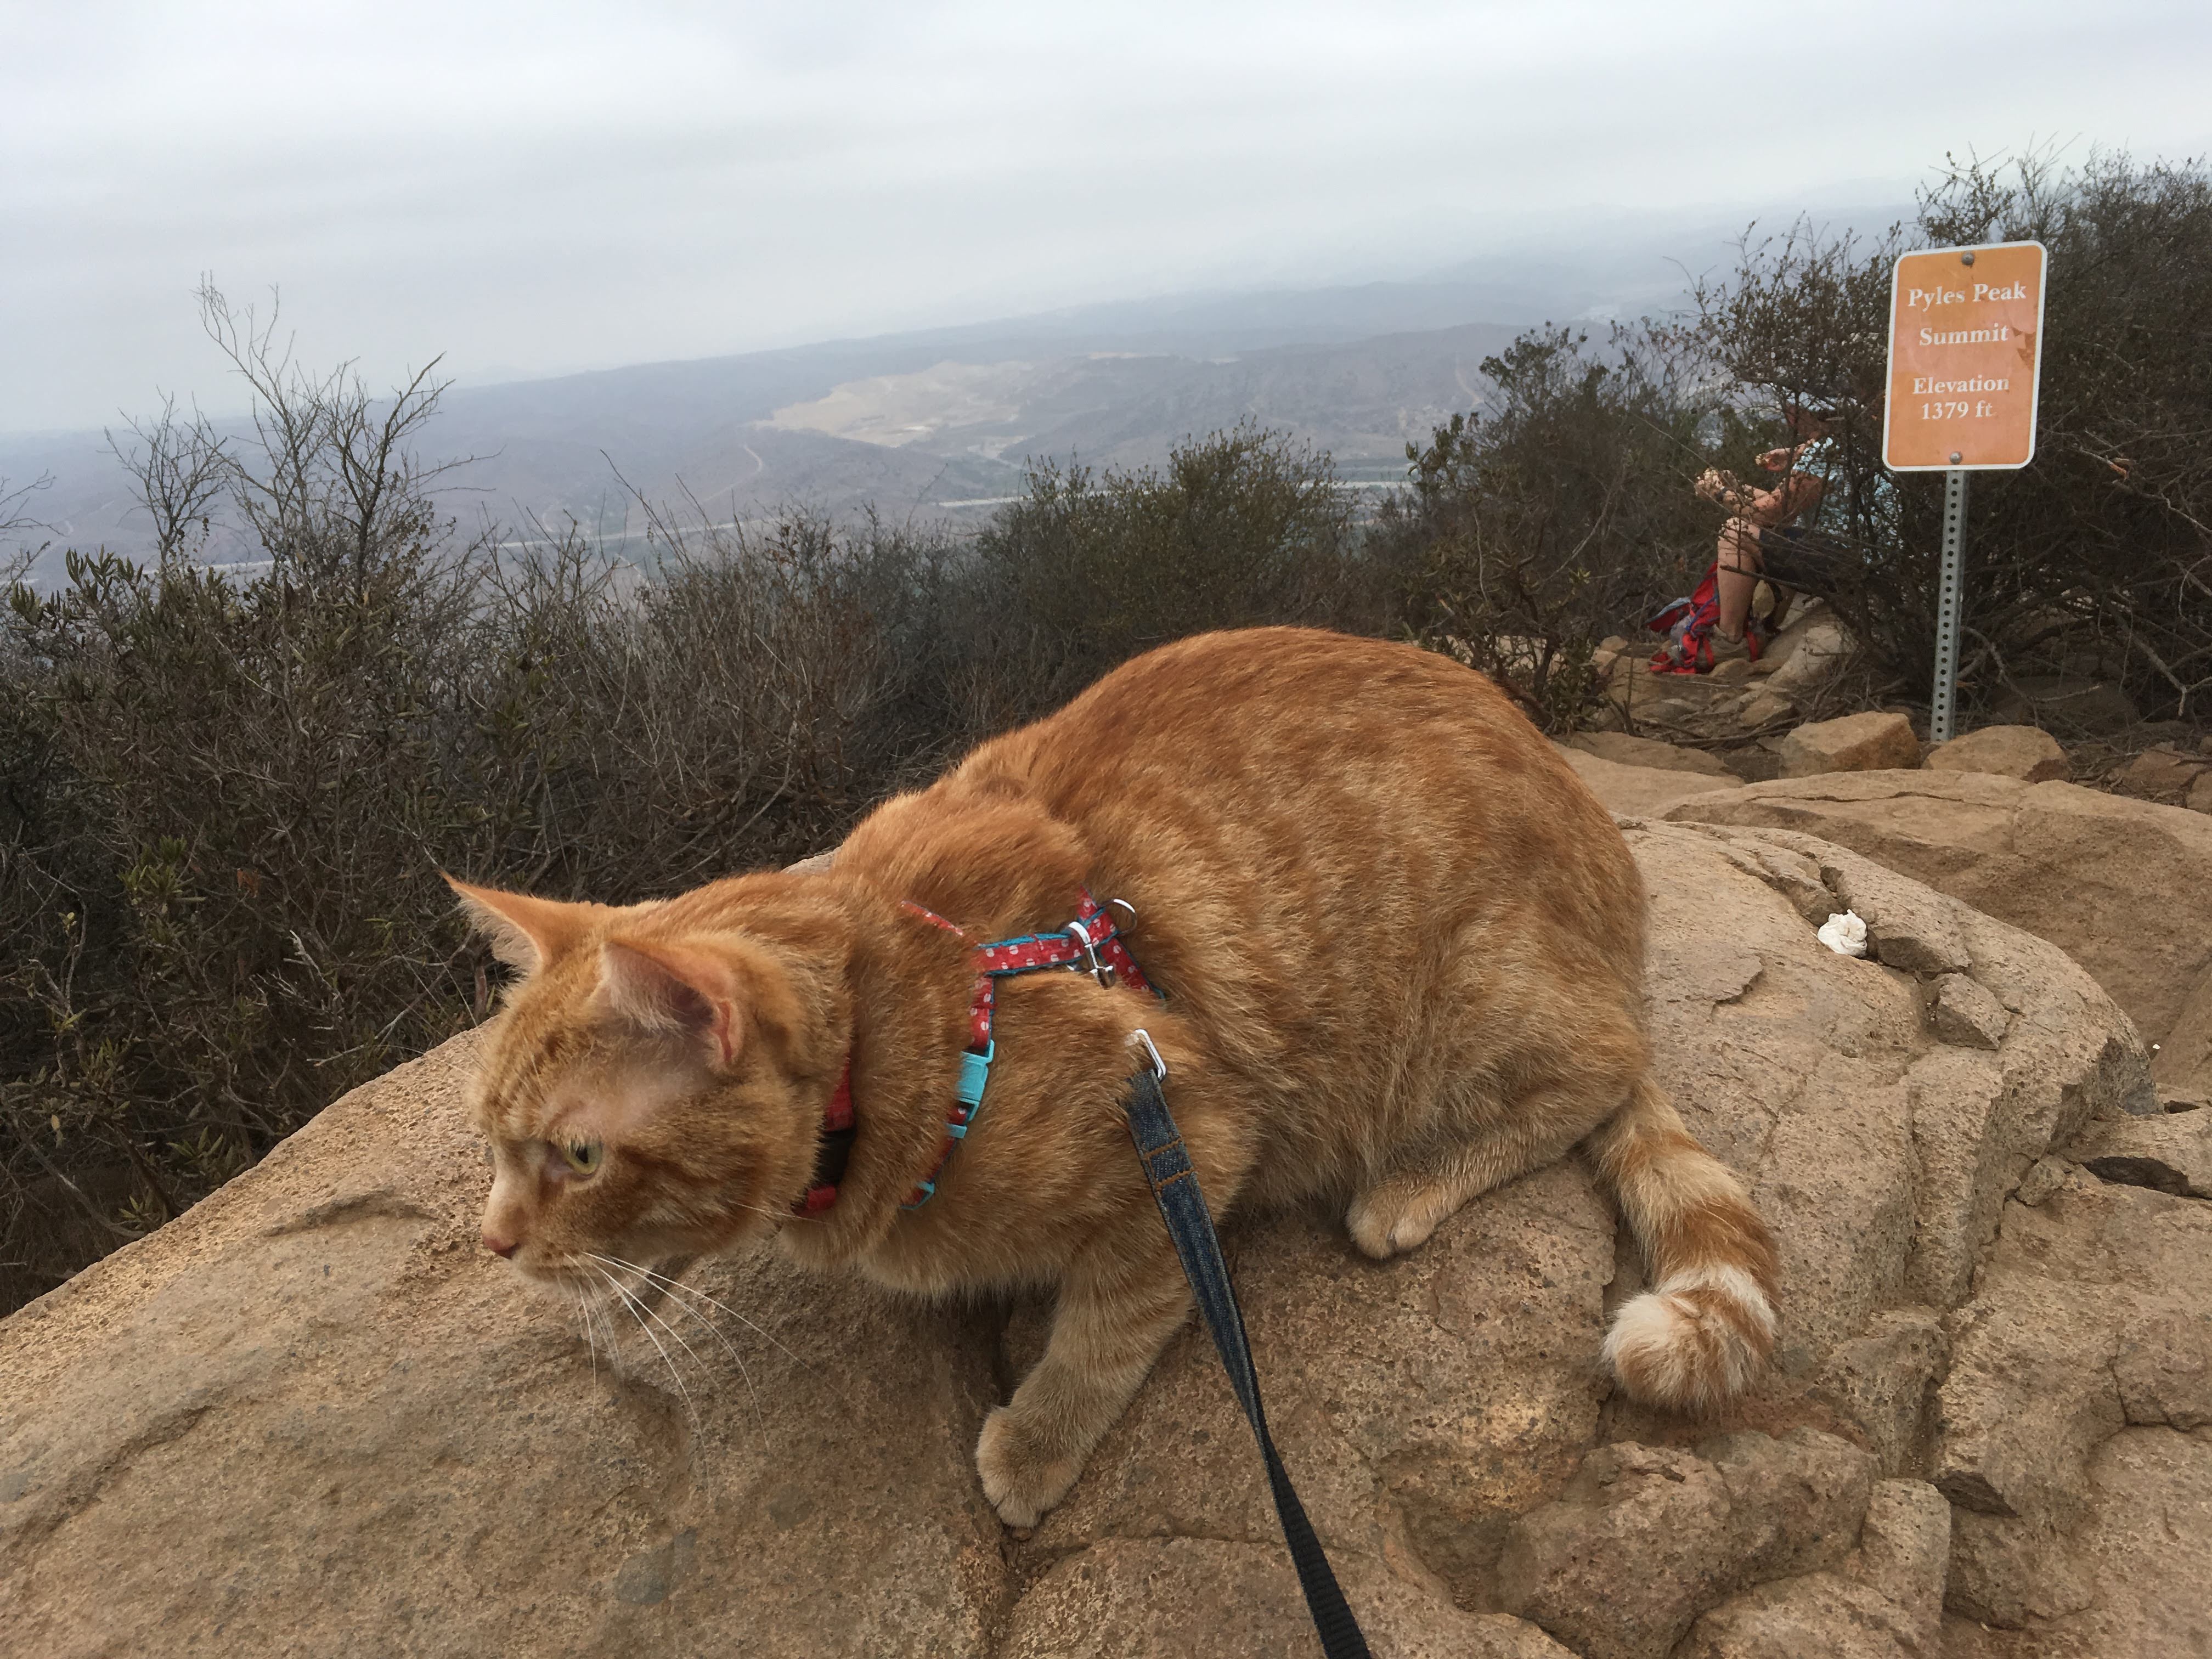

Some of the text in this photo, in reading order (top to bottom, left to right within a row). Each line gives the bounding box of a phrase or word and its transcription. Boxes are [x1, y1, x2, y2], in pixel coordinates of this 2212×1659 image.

[1908, 280, 2027, 312] Pyles Peak
[1919, 323, 2009, 346] Summit
[1912, 375, 2010, 394] Elevation
[1922, 400, 1994, 420] 1379 ft
